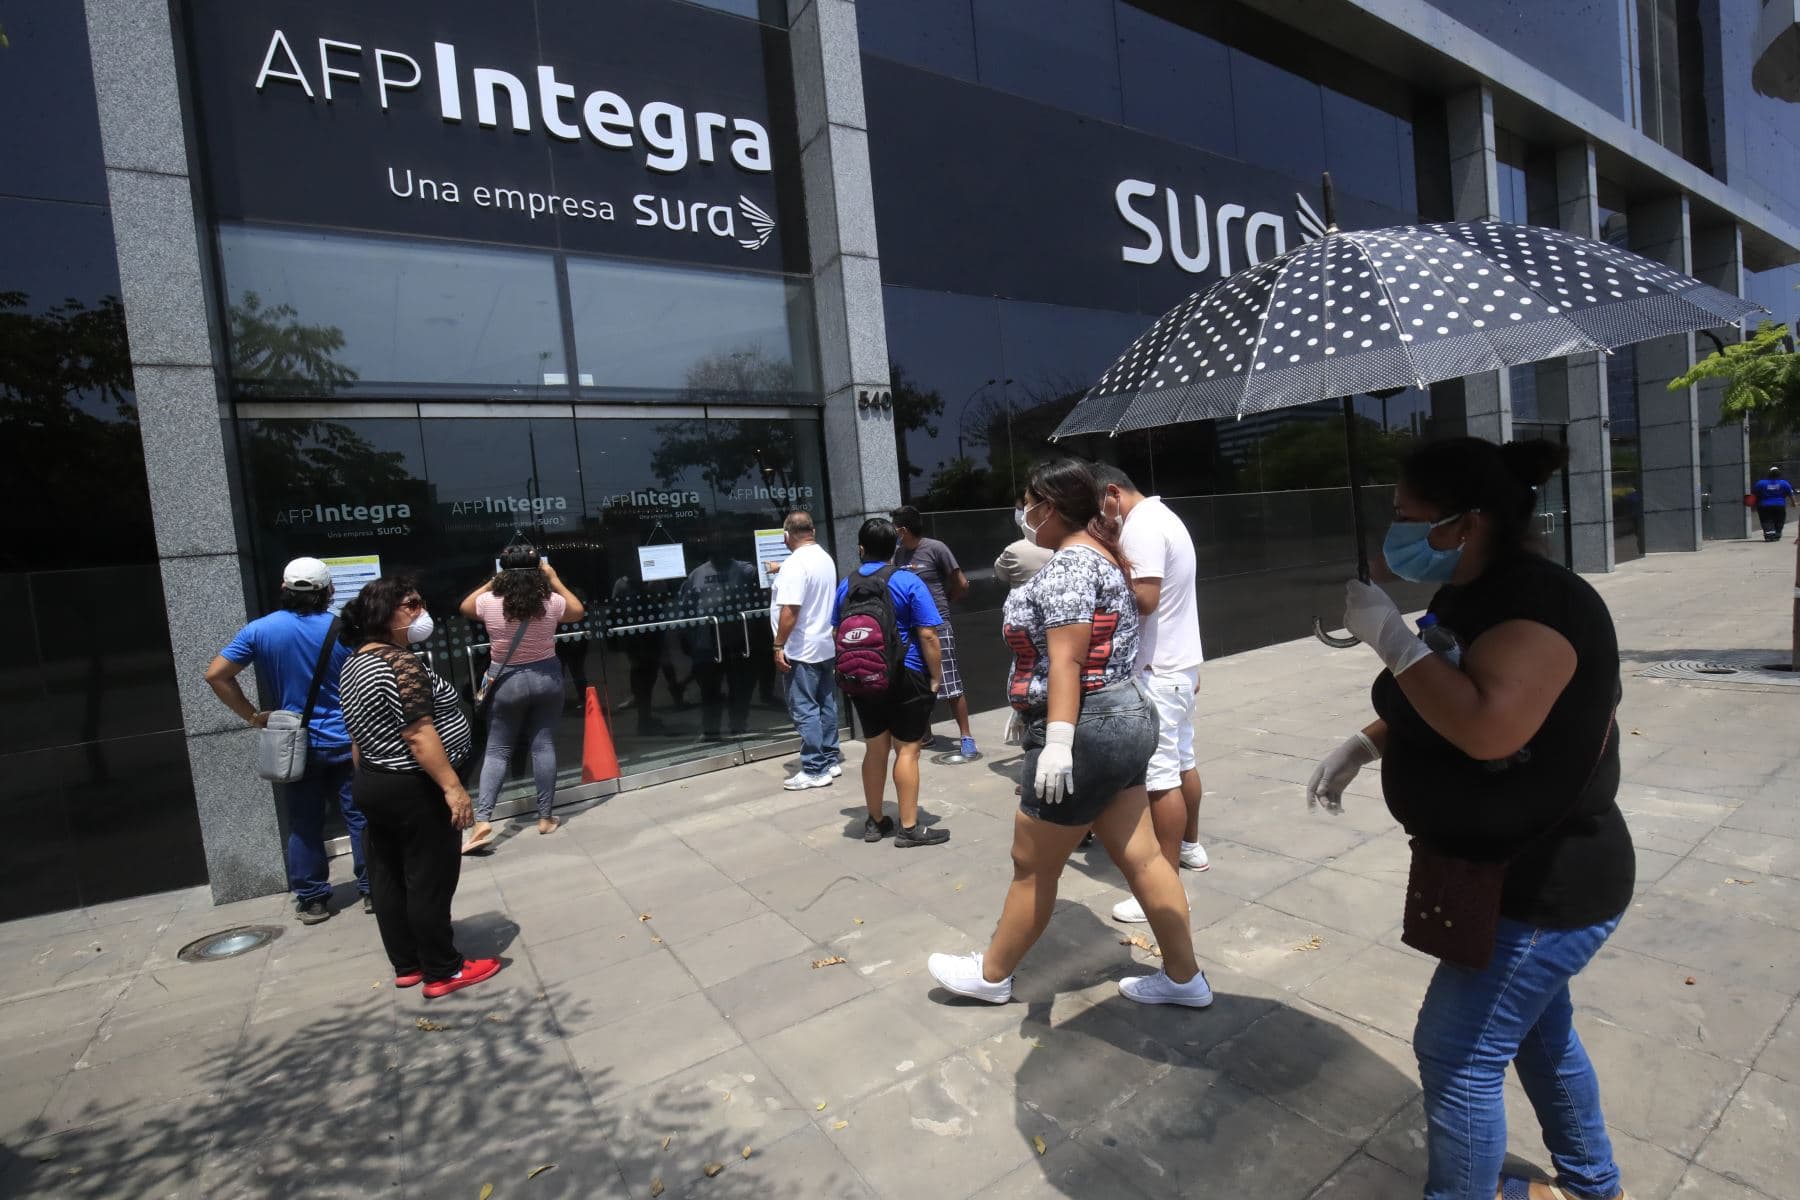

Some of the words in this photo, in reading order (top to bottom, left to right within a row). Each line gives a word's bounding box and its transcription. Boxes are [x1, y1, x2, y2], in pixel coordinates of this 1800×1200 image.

[388, 167, 460, 203] Una
[473, 186, 615, 220] empresa
[633, 194, 736, 238] sura
[858, 390, 892, 410] 540
